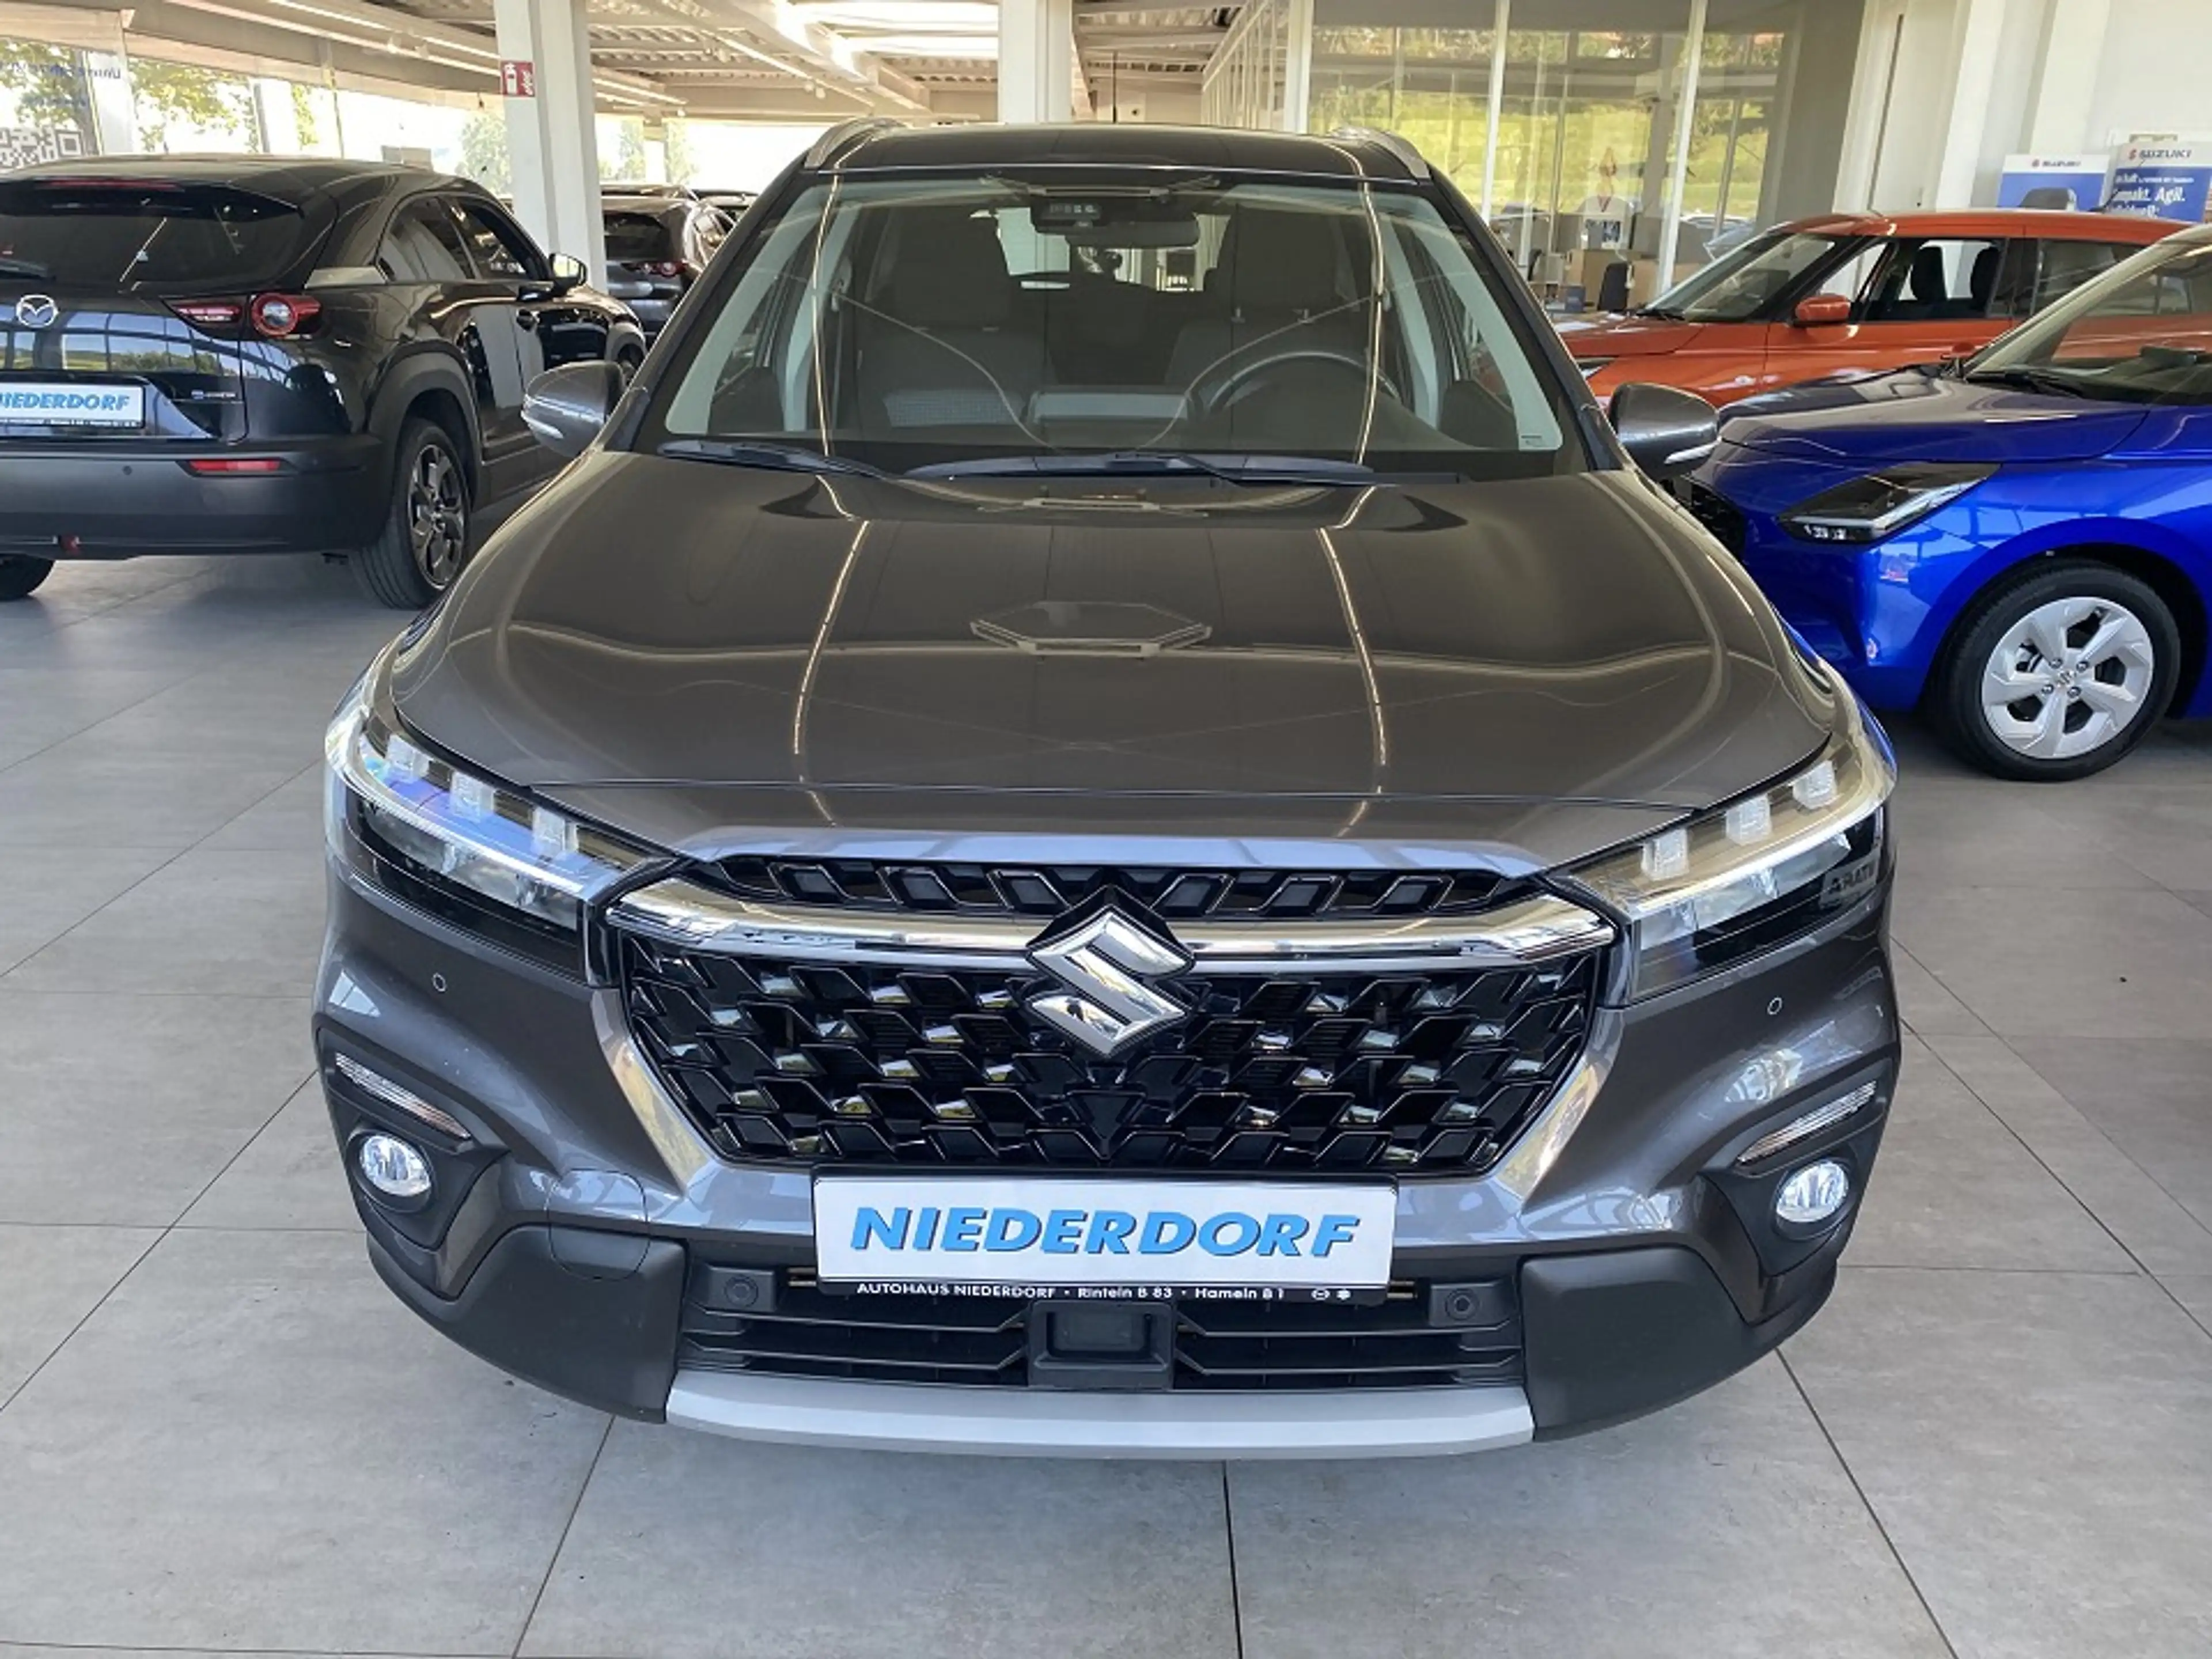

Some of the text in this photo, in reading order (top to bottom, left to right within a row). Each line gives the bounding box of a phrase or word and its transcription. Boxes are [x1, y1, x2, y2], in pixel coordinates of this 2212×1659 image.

[2139, 149, 2192, 158] SUZUKI
[0, 392, 130, 411] IEDERDORF
[851, 1207, 1360, 1257] NIEDERDORF
[857, 1283, 950, 1295] AUTOHAUS
[954, 1285, 1056, 1298] NIEDERDORF
[1153, 1287, 1172, 1298] 83
[1195, 1287, 1257, 1299] Hameln
